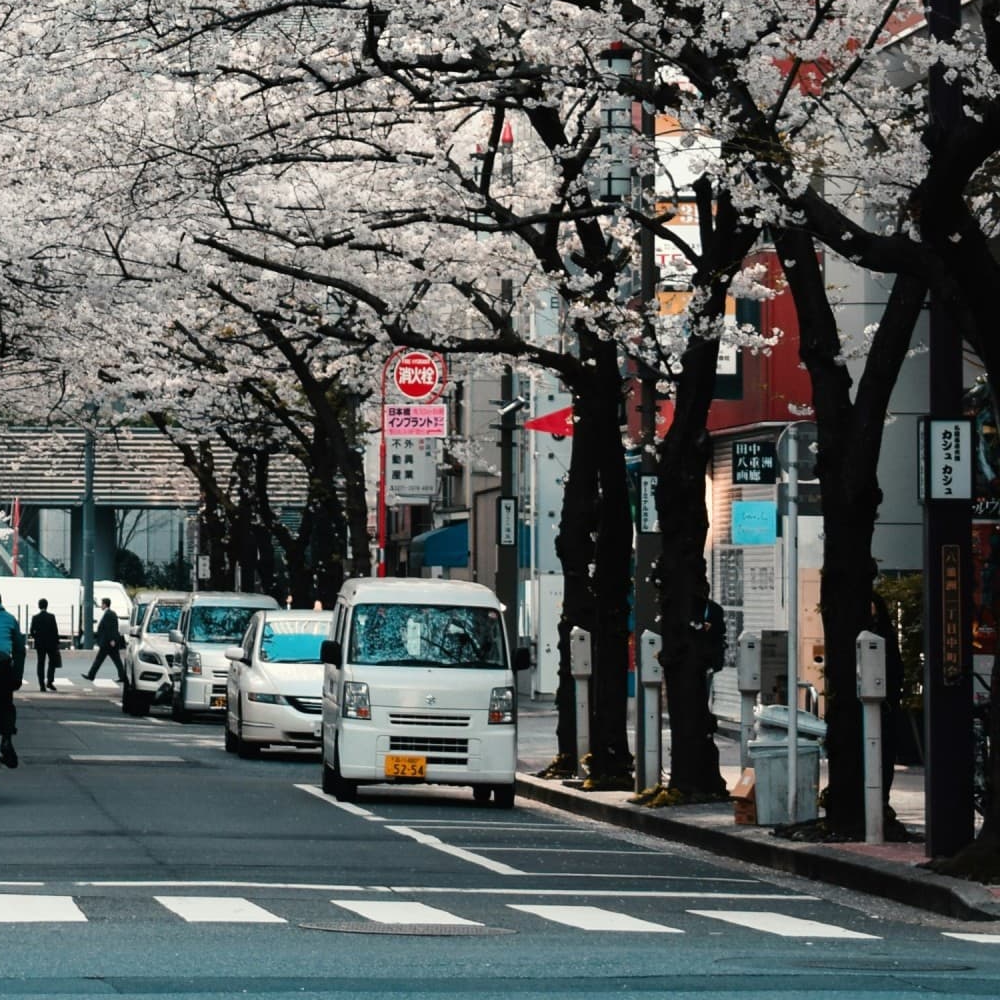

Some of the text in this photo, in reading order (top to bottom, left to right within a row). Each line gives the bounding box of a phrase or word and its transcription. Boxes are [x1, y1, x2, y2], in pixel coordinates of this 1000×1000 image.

[399, 366, 435, 385] 消火栓
[736, 443, 761, 455] 田中
[737, 456, 773, 468] 八重洲
[393, 763, 424, 776] 52-54
